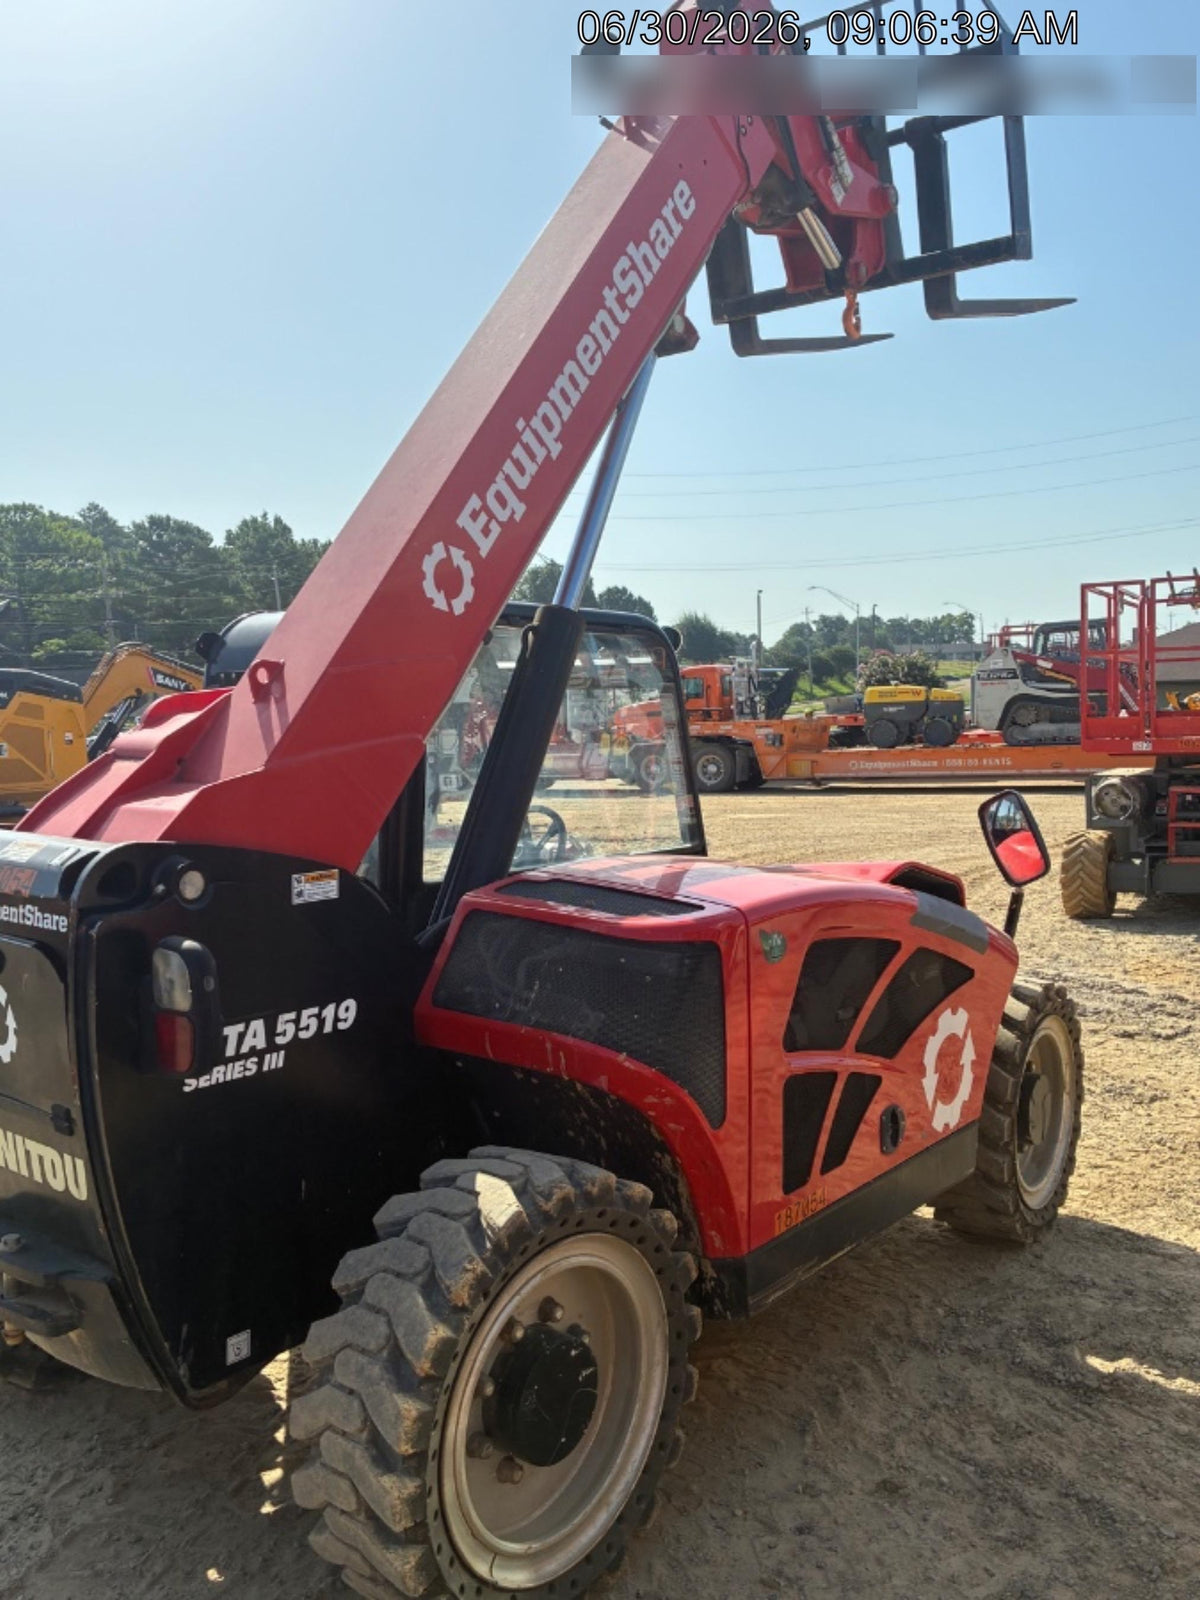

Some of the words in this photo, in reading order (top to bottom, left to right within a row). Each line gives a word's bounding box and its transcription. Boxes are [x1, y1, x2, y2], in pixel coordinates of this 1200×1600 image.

[456, 179, 696, 558] EquipmentShare
[156, 674, 186, 690] SANY
[0, 904, 68, 933] entShare
[222, 1018, 267, 1057] TA
[274, 998, 358, 1045] 5519
[262, 1050, 285, 1073] III
